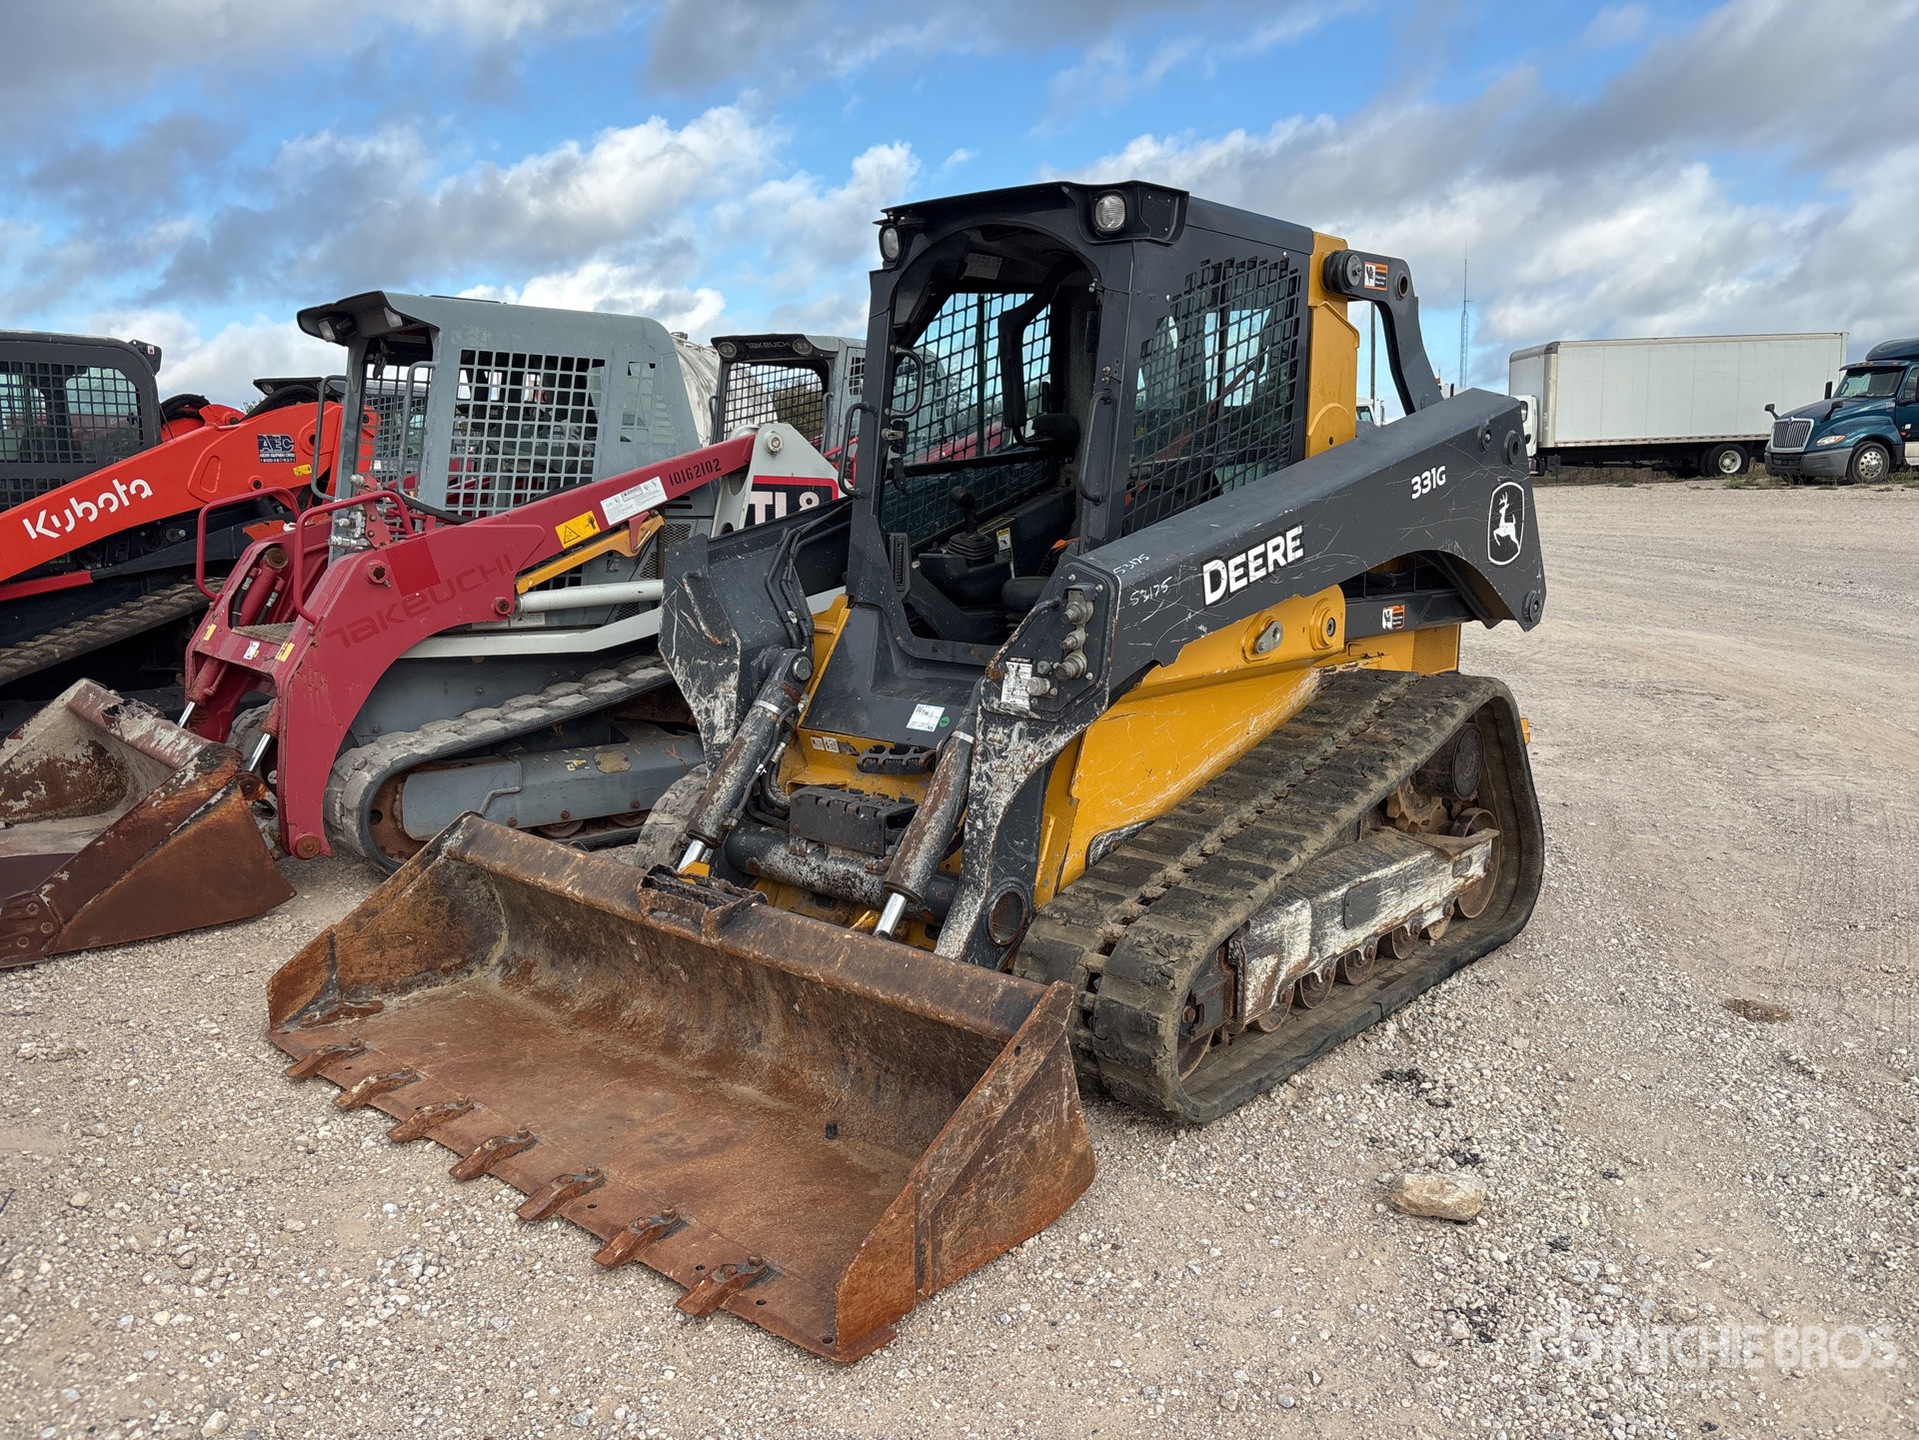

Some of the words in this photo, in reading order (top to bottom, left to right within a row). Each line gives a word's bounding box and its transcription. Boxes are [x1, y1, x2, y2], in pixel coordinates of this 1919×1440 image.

[257, 434, 295, 451] AEC
[668, 458, 722, 486] 10162102
[1411, 465, 1446, 500] 331G
[22, 478, 153, 540] Kubota
[1203, 525, 1304, 606] DEERE
[1130, 576, 1173, 606] 53175
